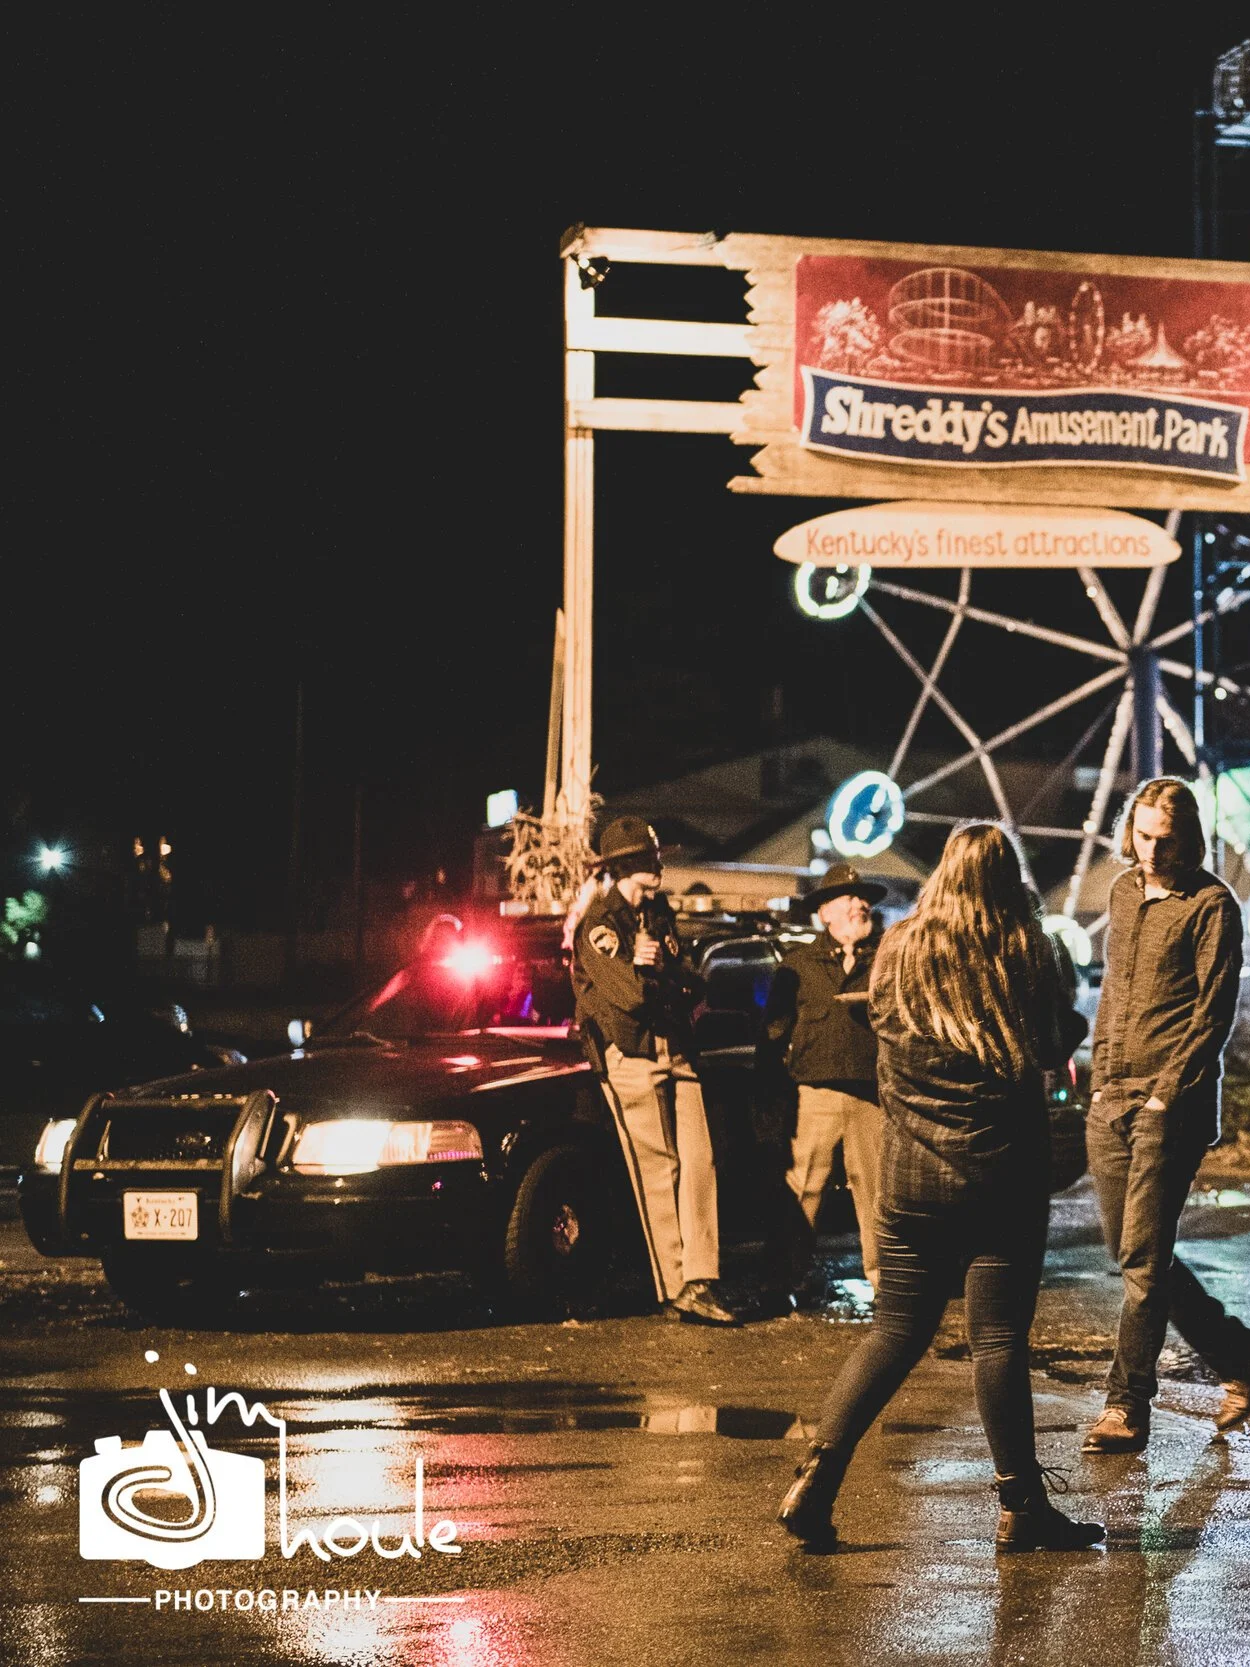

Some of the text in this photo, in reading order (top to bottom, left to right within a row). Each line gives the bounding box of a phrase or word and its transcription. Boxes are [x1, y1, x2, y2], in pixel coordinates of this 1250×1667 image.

[820, 386, 1229, 459] Shreddy's Amusement Park
[806, 528, 1152, 561] Kentucky's finest attractions
